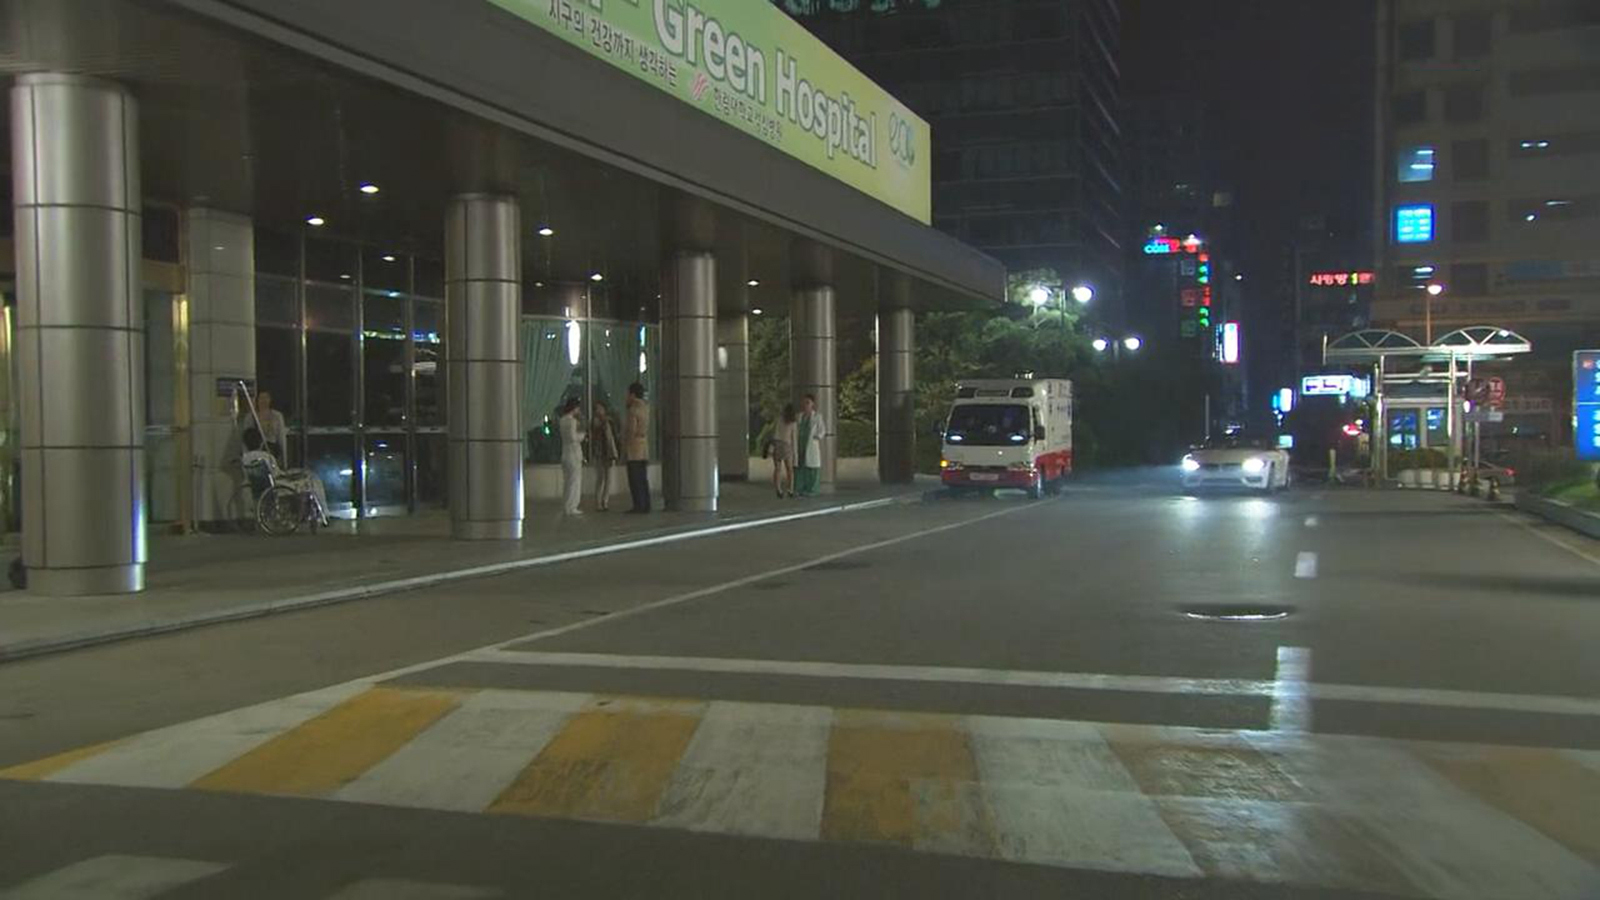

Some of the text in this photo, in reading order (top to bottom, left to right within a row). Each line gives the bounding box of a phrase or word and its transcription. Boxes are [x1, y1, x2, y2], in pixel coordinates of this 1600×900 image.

[590, 18, 635, 64] 건강까지
[638, 45, 677, 88] 생각하는
[653, 0, 877, 168] Green Hospital
